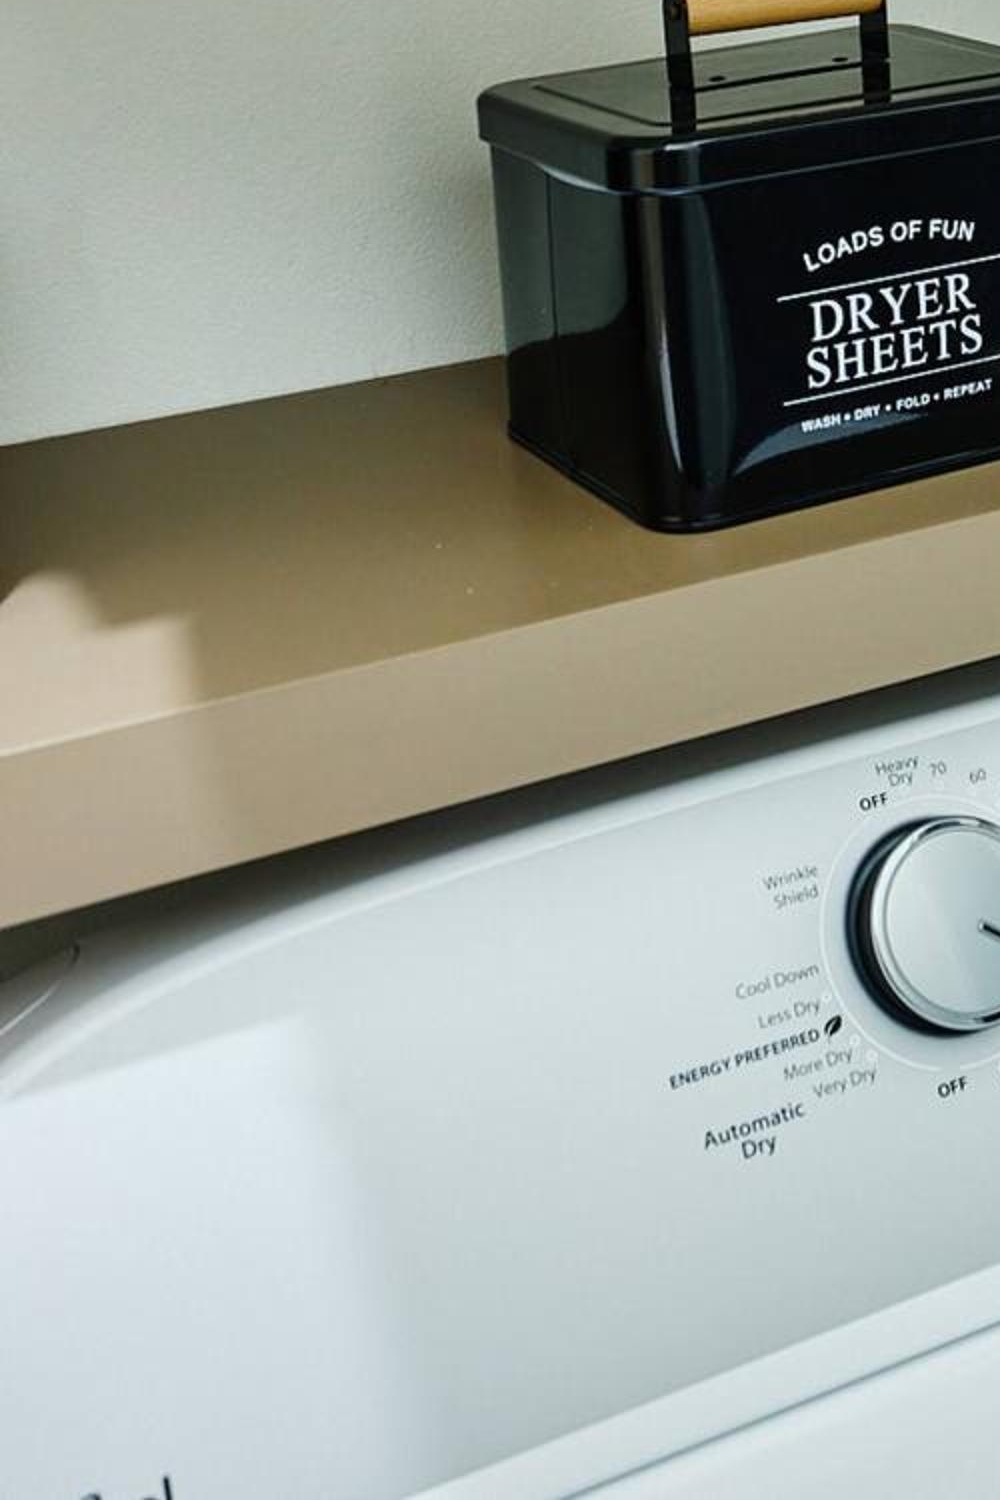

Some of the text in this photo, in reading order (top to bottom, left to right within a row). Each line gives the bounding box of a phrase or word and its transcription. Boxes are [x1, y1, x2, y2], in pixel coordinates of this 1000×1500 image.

[803, 218, 975, 272] LOADS OF FUN
[809, 273, 976, 342] DRYER
[806, 314, 983, 389] SHEETS
[801, 379, 993, 432] WASH DRY FOLD REPEAT
[875, 756, 919, 777] Heavy
[888, 771, 913, 788] Dry
[930, 761, 947, 777] 70
[969, 768, 987, 784] 60
[859, 792, 888, 812] OFF
[762, 865, 817, 890] Wrinkle
[774, 884, 819, 910] Shield
[735, 964, 819, 999] Cool Down
[758, 1000, 819, 1029] Less Dry
[669, 1028, 820, 1090] ENERGY PREFERRED
[783, 1048, 853, 1081] More Dry
[813, 1067, 877, 1098] Very Dry
[937, 1076, 968, 1098] OFF
[704, 1102, 805, 1150] Automatic
[741, 1135, 777, 1160] Dry
